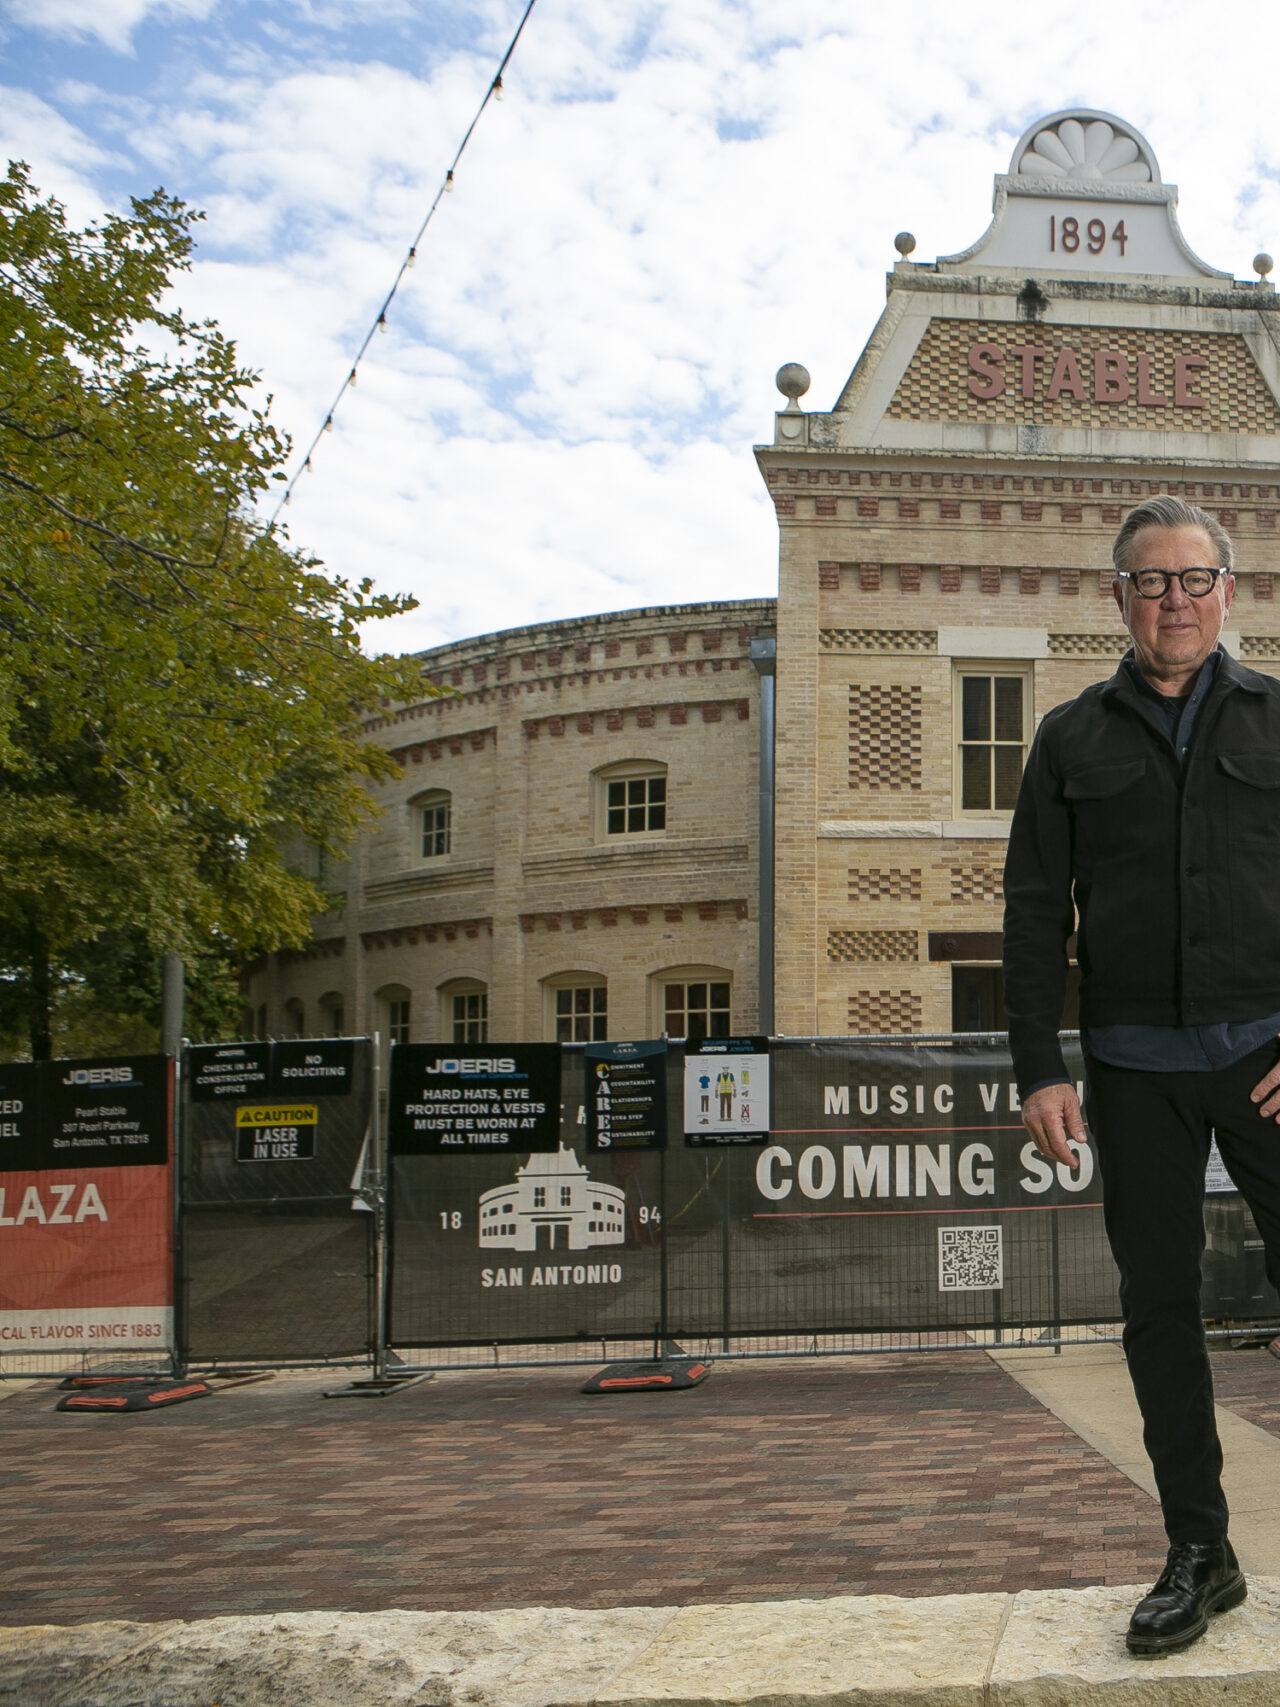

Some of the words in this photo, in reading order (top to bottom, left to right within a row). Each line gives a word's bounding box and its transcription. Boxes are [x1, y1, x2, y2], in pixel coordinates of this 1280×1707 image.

[1050, 214, 1128, 257] 1894
[966, 343, 1208, 408] STABLE
[305, 1055, 322, 1065] NO
[425, 1058, 516, 1074] JOERIS
[203, 1064, 233, 1073] CHECK
[246, 1062, 258, 1070] AT
[281, 1066, 346, 1078] SOLICITING
[62, 1067, 133, 1085] JOERIS
[196, 1073, 265, 1084] CONSTRUCTION
[214, 1085, 247, 1094] OFFICE
[423, 1089, 461, 1100] HARD
[464, 1089, 501, 1101] HATS,
[503, 1088, 530, 1099] EYE
[824, 1084, 954, 1115] MUSIC
[75, 1107, 98, 1118] Pearl
[99, 1106, 127, 1116] Stable
[405, 1104, 489, 1115] PROTECTION
[491, 1104, 501, 1114] &
[503, 1103, 546, 1114] VESTS
[253, 1110, 314, 1122] CAUTION
[79, 1122, 101, 1132] Pearl
[414, 1119, 453, 1130] MUST
[455, 1119, 474, 1129] BE
[475, 1118, 518, 1129] WORN
[520, 1118, 536, 1128] AT
[52, 1139, 70, 1148] San
[110, 1135, 121, 1145] TX
[255, 1128, 298, 1143] LASER
[440, 1134, 465, 1144] ALL
[467, 1133, 509, 1144] TIMES
[253, 1145, 268, 1158] IN
[271, 1143, 298, 1157] USE
[756, 1143, 996, 1200] COMING
[1019, 1139, 1094, 1194] SO
[440, 1211, 462, 1230] 18
[639, 1206, 661, 1224] 94
[481, 1267, 523, 1287] SAN
[530, 1264, 622, 1285] ANTONIO
[0, 1327, 26, 1340] CAL
[30, 1325, 83, 1339] FLAVOR
[88, 1324, 128, 1338] SINCE
[131, 1324, 162, 1337] 1883
